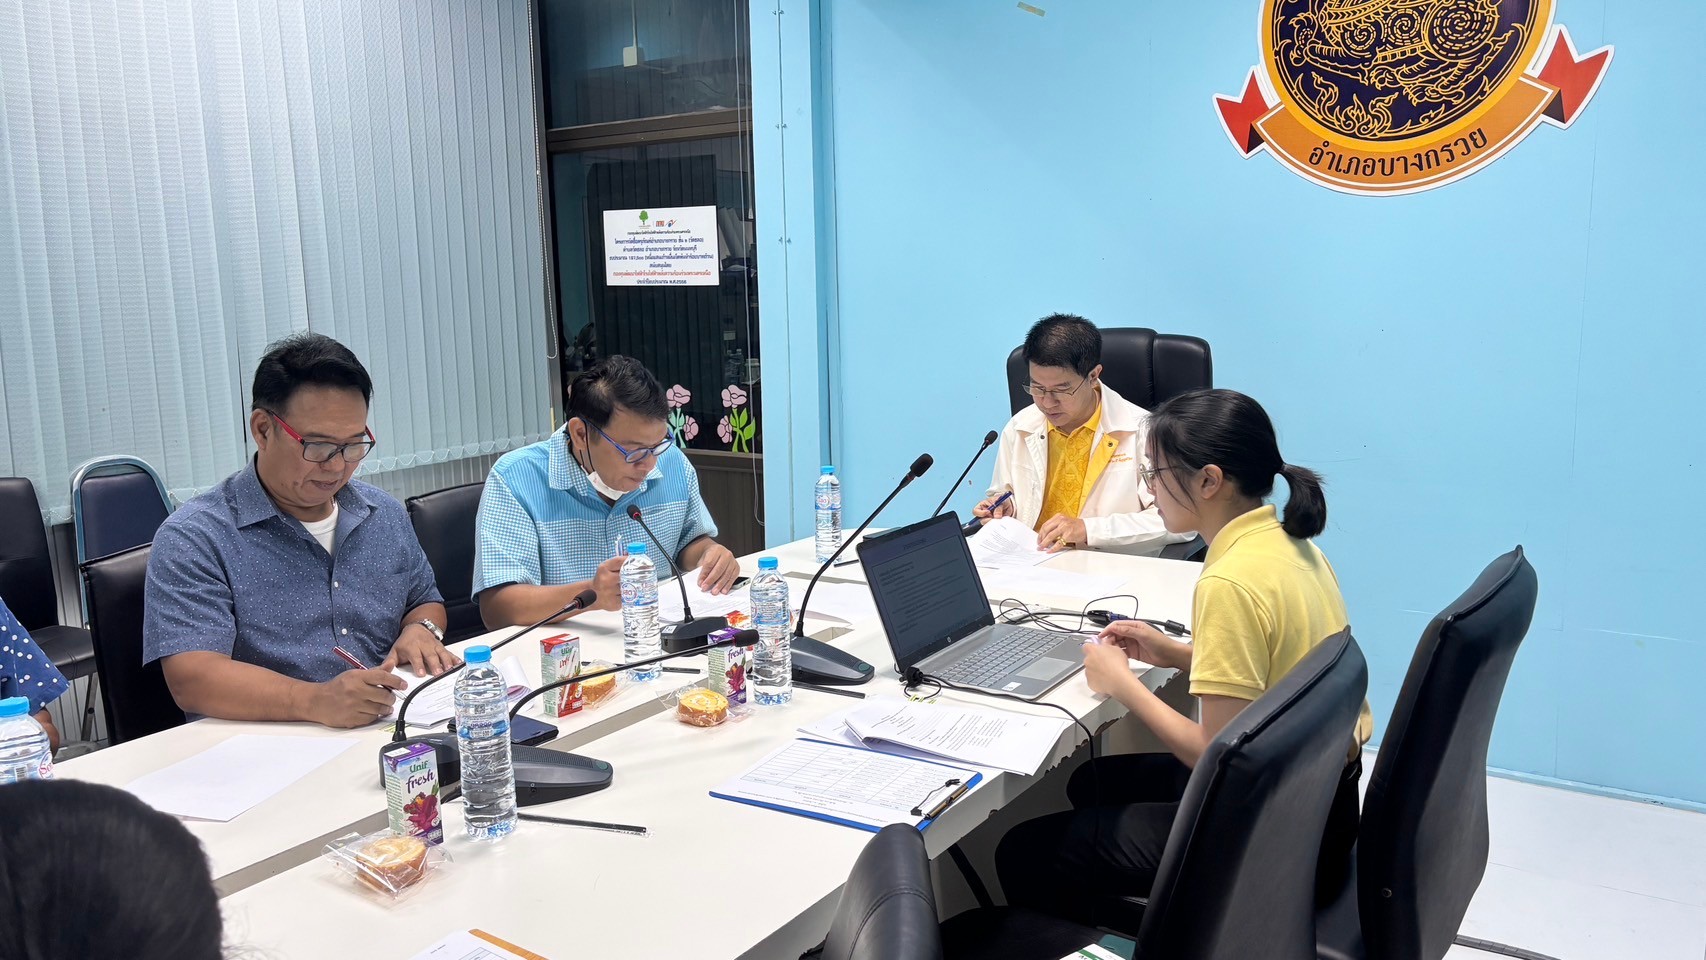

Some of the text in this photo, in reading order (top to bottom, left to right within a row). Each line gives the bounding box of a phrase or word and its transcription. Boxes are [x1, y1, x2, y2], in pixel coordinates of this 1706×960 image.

[1308, 128, 1488, 177] อำเภอบางกรวย
[406, 769, 435, 794] fresh
